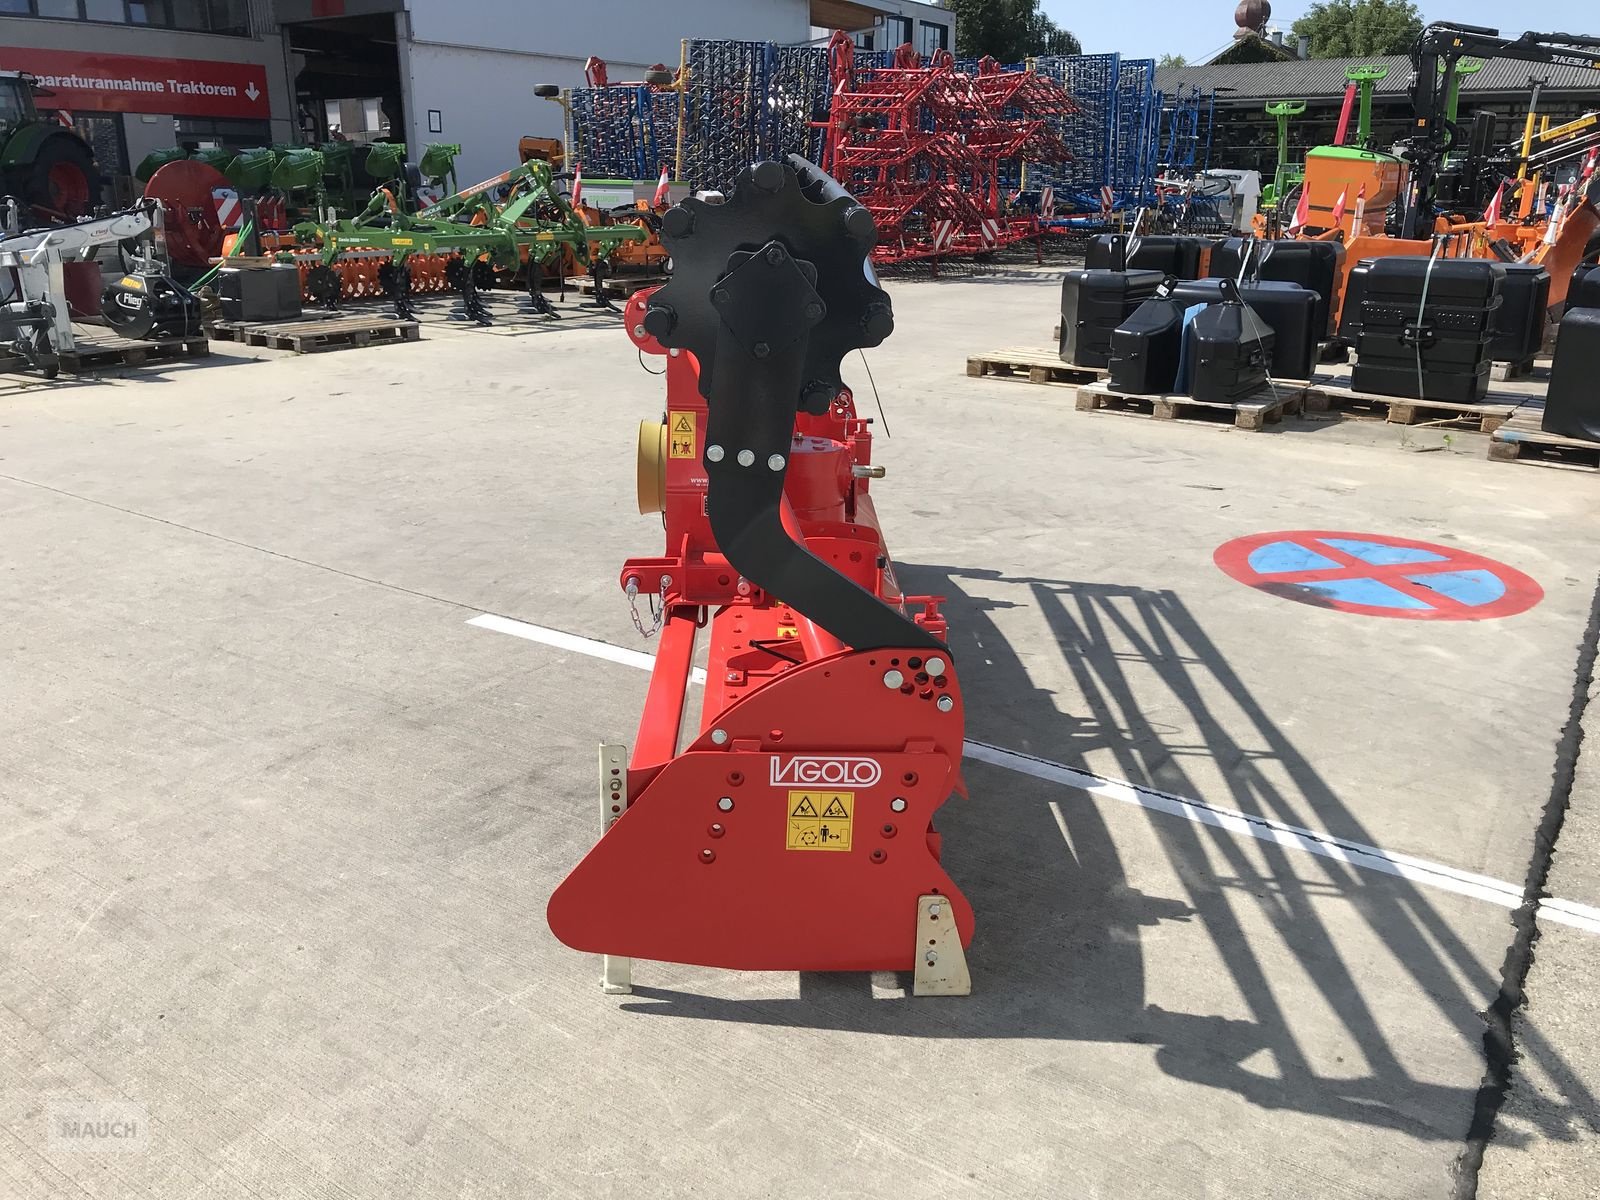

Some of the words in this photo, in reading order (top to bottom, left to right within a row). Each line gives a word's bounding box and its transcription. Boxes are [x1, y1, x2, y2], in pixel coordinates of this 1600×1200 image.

[1558, 55, 1593, 67] KESLA
[34, 74, 164, 92] paraturannahme
[166, 79, 237, 96] Traktoren
[770, 756, 881, 787] VIGOLO
